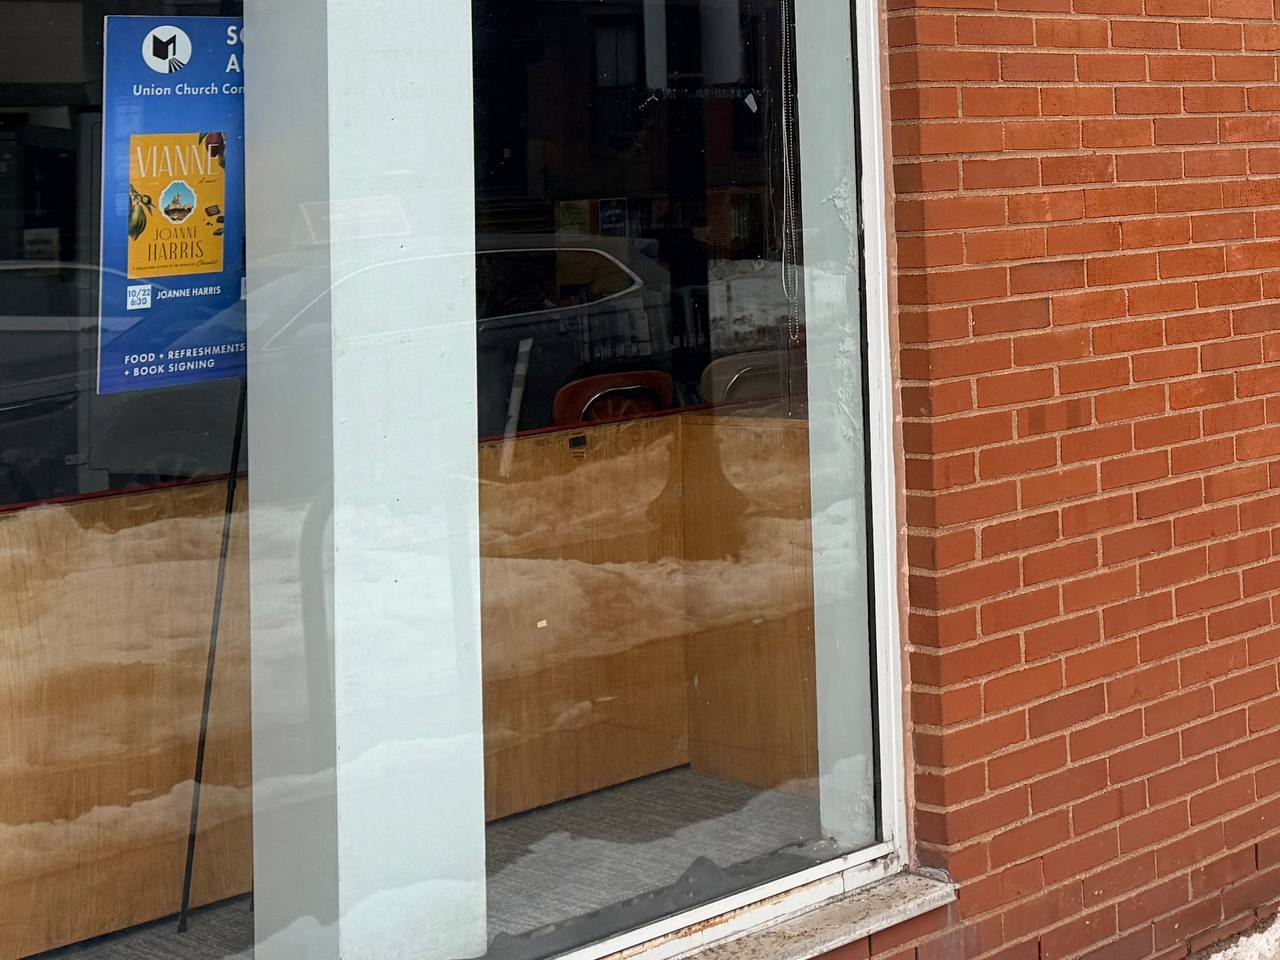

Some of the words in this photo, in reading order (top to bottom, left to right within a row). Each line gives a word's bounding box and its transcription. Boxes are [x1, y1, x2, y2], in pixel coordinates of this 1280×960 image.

[226, 25, 244, 46] S
[132, 83, 171, 96] Union
[175, 82, 218, 95] Church
[137, 143, 219, 178] VIANNE
[153, 226, 199, 241] JOANNE
[148, 240, 204, 262] HARRIS
[128, 288, 151, 299] 10/22
[156, 288, 191, 300] JOANNE
[191, 286, 221, 296] HARRIS
[124, 352, 156, 365] FOOD
[167, 343, 246, 360] REFRESHMENTS
[133, 364, 165, 377] BOOK
[168, 359, 215, 373] SIGNING
